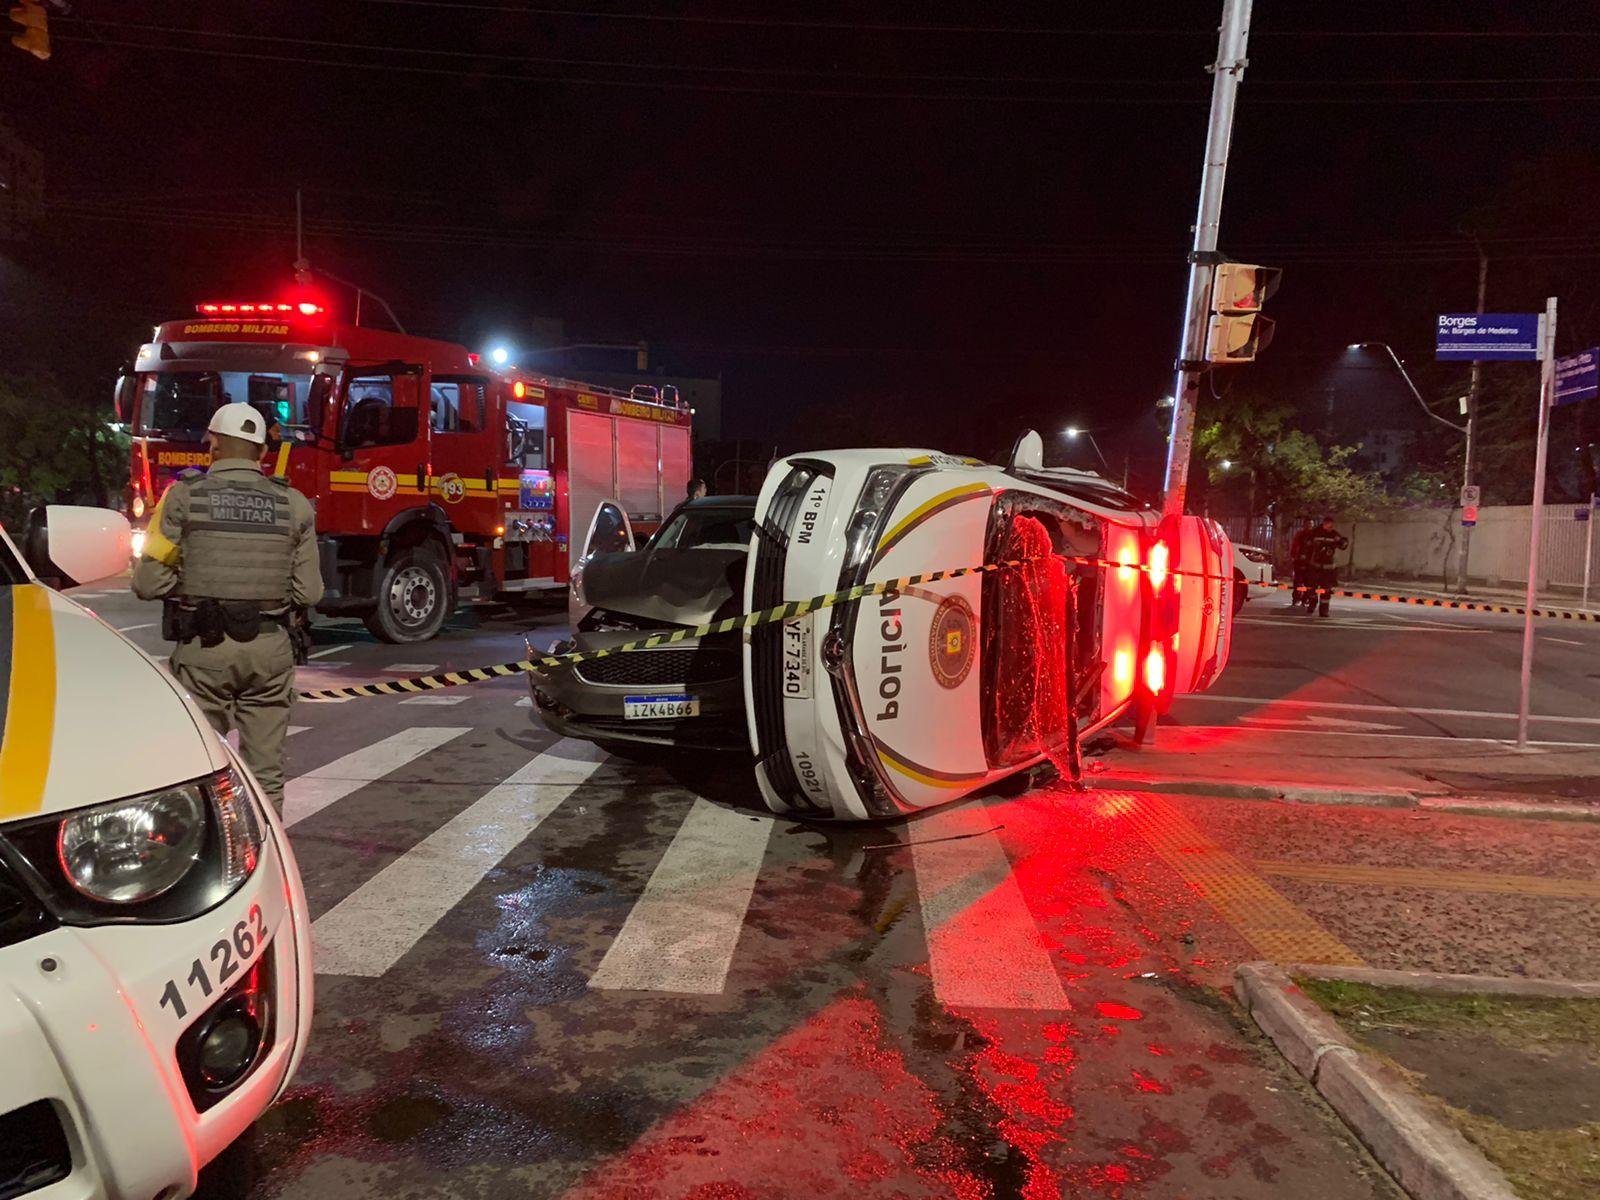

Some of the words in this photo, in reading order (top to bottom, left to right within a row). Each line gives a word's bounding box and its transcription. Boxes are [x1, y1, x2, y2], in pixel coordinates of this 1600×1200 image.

[184, 323, 240, 334] BOMBEIRO
[241, 324, 289, 335] MILITAR
[1439, 316, 1477, 329] Borges
[1452, 328, 1476, 336] Borges
[1488, 327, 1519, 335] Medeiros
[443, 481, 463, 495] 193
[210, 494, 274, 510] BRIGADA
[212, 507, 273, 523] MILITAR
[797, 511, 818, 545] BPM
[632, 702, 693, 718] IZK4B66
[795, 751, 823, 794] 10921
[159, 903, 268, 1020] 11262
